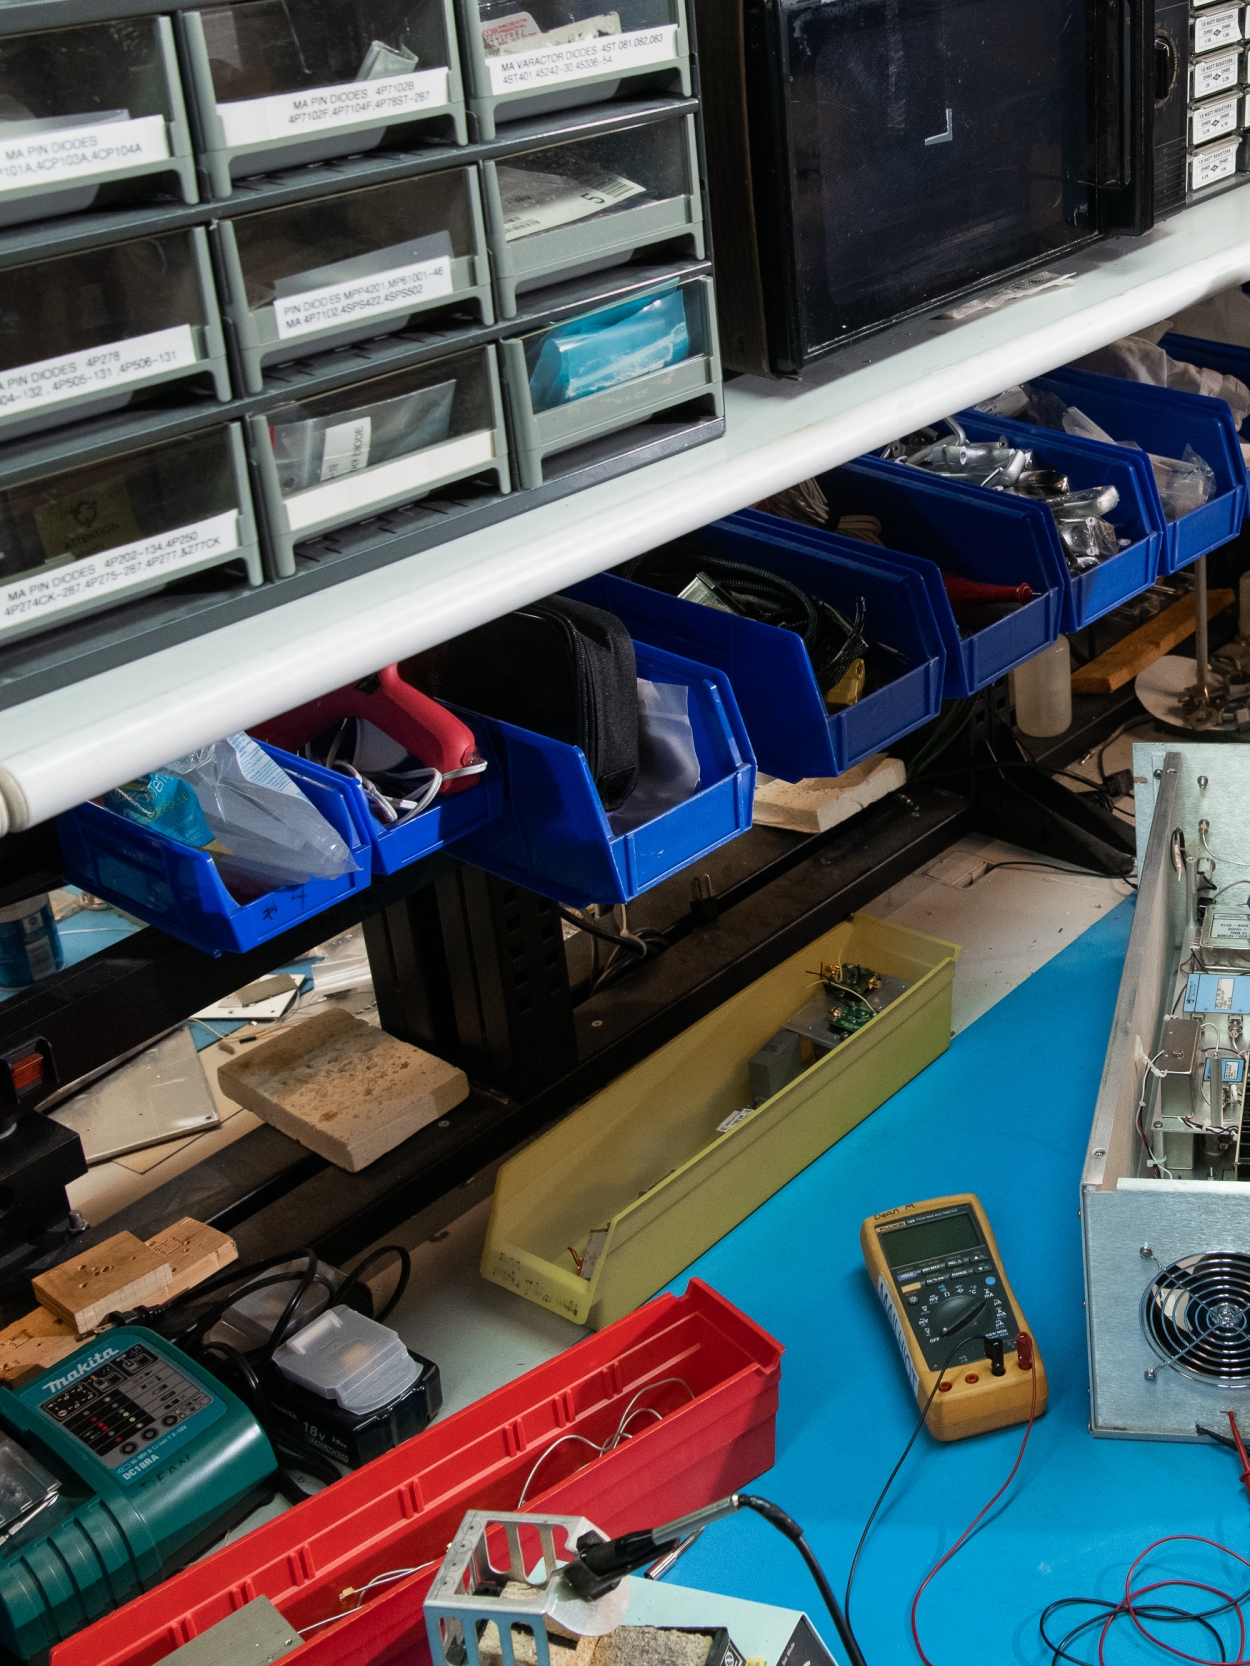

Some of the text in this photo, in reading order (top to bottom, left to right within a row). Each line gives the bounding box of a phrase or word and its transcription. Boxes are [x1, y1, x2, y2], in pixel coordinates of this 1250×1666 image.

[1203, 28, 1213, 36] OHMS
[1206, 18, 1216, 26] WATT
[1216, 14, 1234, 23] RESISTORS
[501, 62, 515, 73] MA
[516, 53, 564, 70] VARACTOR
[566, 46, 597, 60] DIODES
[601, 41, 617, 53] 4ST
[1215, 58, 1233, 68] RESISTORS
[293, 81, 414, 111] MA PIN DIODES 4P7102B
[1214, 103, 1232, 114] RESISTORS
[5, 135, 98, 161] MA PIN DIODES
[1204, 155, 1213, 163] WATT
[1213, 148, 1231, 159] RESISTORS
[284, 304, 301, 317] PIN
[303, 293, 341, 312] DIODES
[7, 376, 28, 388] PIN
[31, 362, 77, 383] DIODES
[86, 351, 121, 369] 4P278
[52, 367, 113, 391] 4P505-131
[352, 426, 363, 456] DIODE
[7, 589, 26, 602] MA
[29, 580, 49, 596] PIN
[53, 565, 96, 588] DIODES
[874, 1208, 899, 1221] Dean
[122, 1453, 160, 1481] DC18RA
[130, 1451, 148, 1465] Ni-MH
